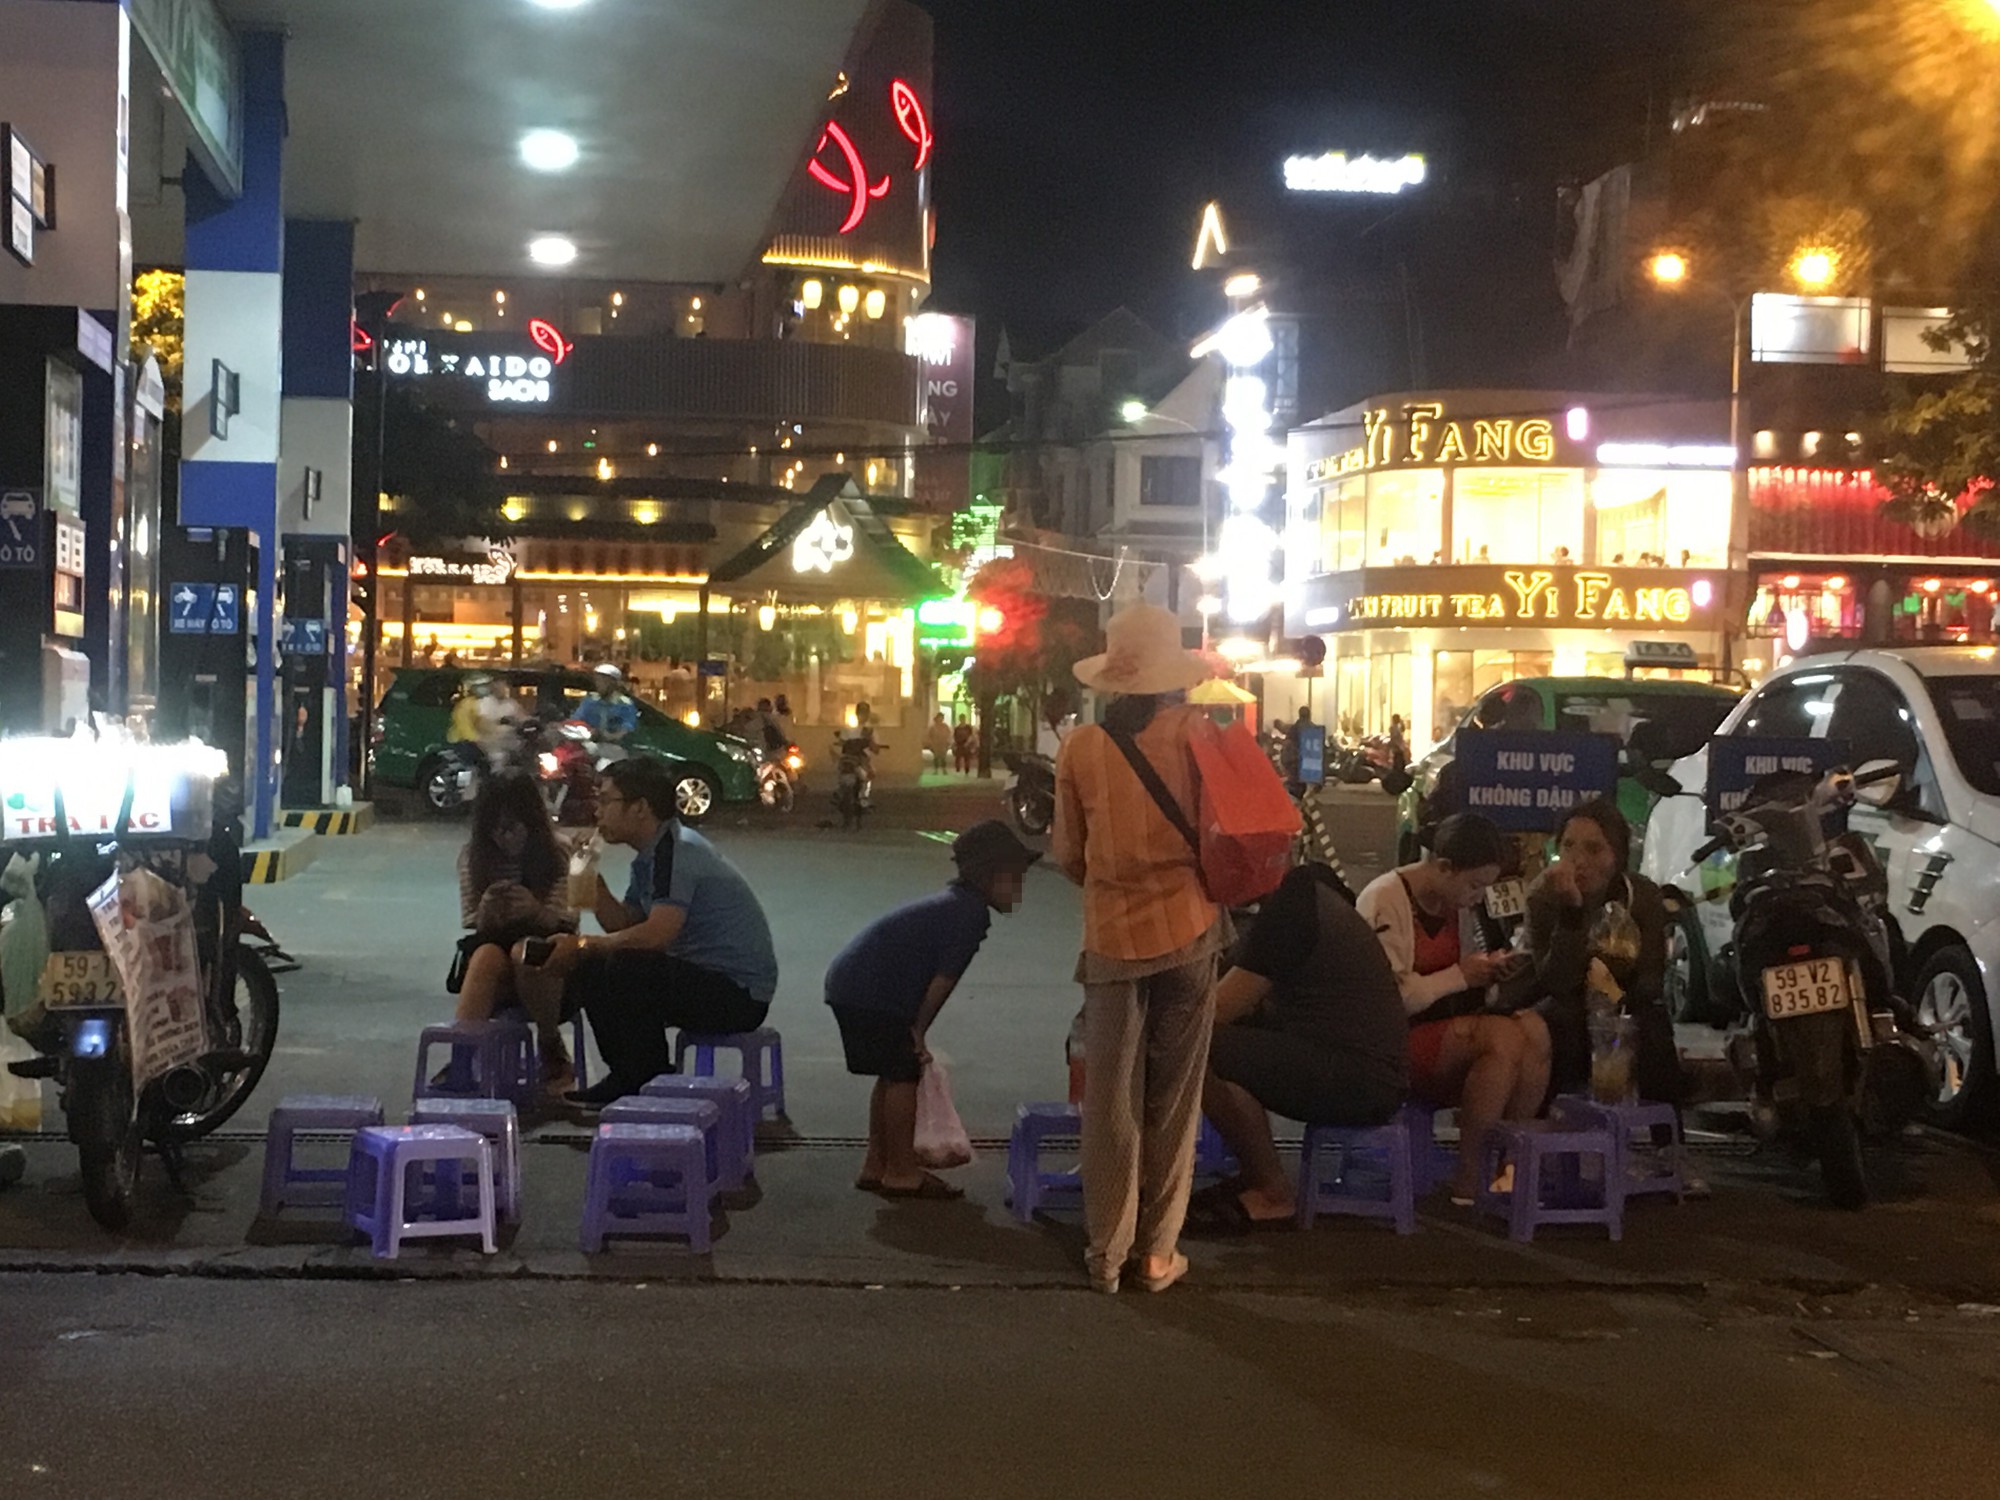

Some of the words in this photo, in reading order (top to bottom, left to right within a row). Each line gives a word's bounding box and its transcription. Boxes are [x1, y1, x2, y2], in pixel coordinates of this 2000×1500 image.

[1450, 592, 1506, 619] TEA
[1574, 571, 1691, 623] FANG
[1496, 751, 1535, 771] KHU
[1744, 755, 1778, 775] KHU
[1468, 783, 1532, 808] KHÔNG
[1774, 962, 1832, 990] 59-V2
[1770, 983, 1841, 1014] 835.82
